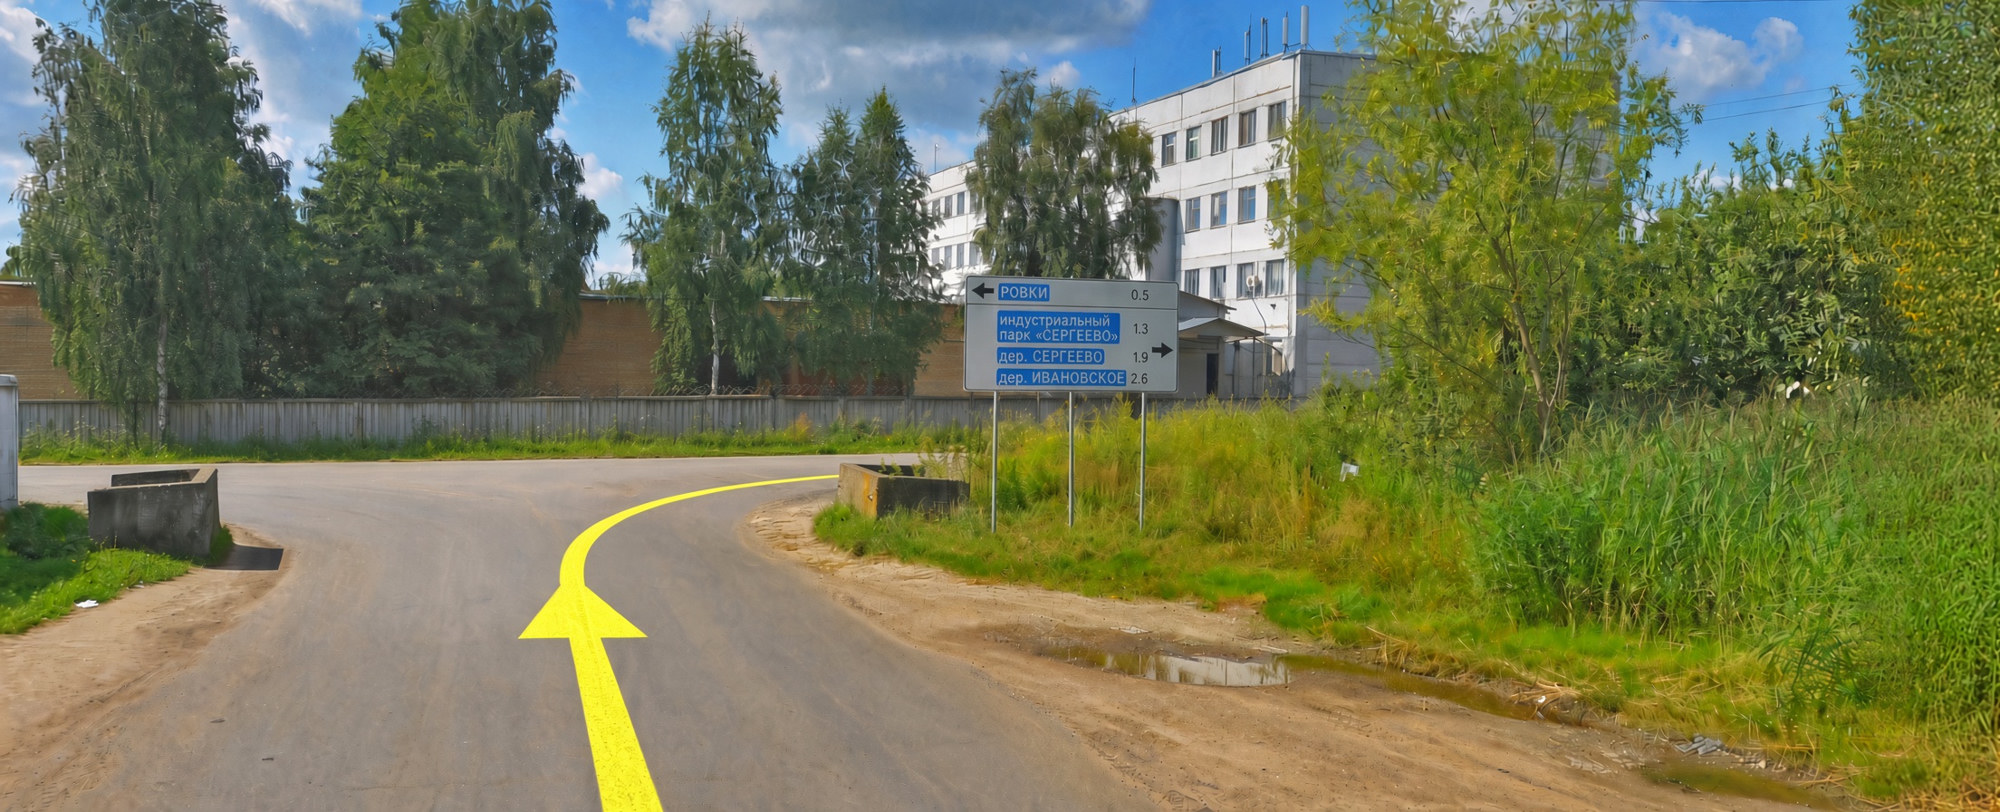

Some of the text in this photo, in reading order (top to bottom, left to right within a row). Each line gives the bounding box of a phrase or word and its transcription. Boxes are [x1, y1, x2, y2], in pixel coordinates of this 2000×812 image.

[1000, 286, 1149, 301] РОВКИ 0.5
[999, 314, 1110, 328] индустриальный
[999, 329, 1118, 343] парк «СЕРГЕЕВО»
[1133, 323, 1149, 335] 1.3
[998, 350, 1148, 363] дер. СЕРГЕЕВО 1.9
[998, 371, 1148, 385] дер. ИВАНОВСКОЕ 2.6
